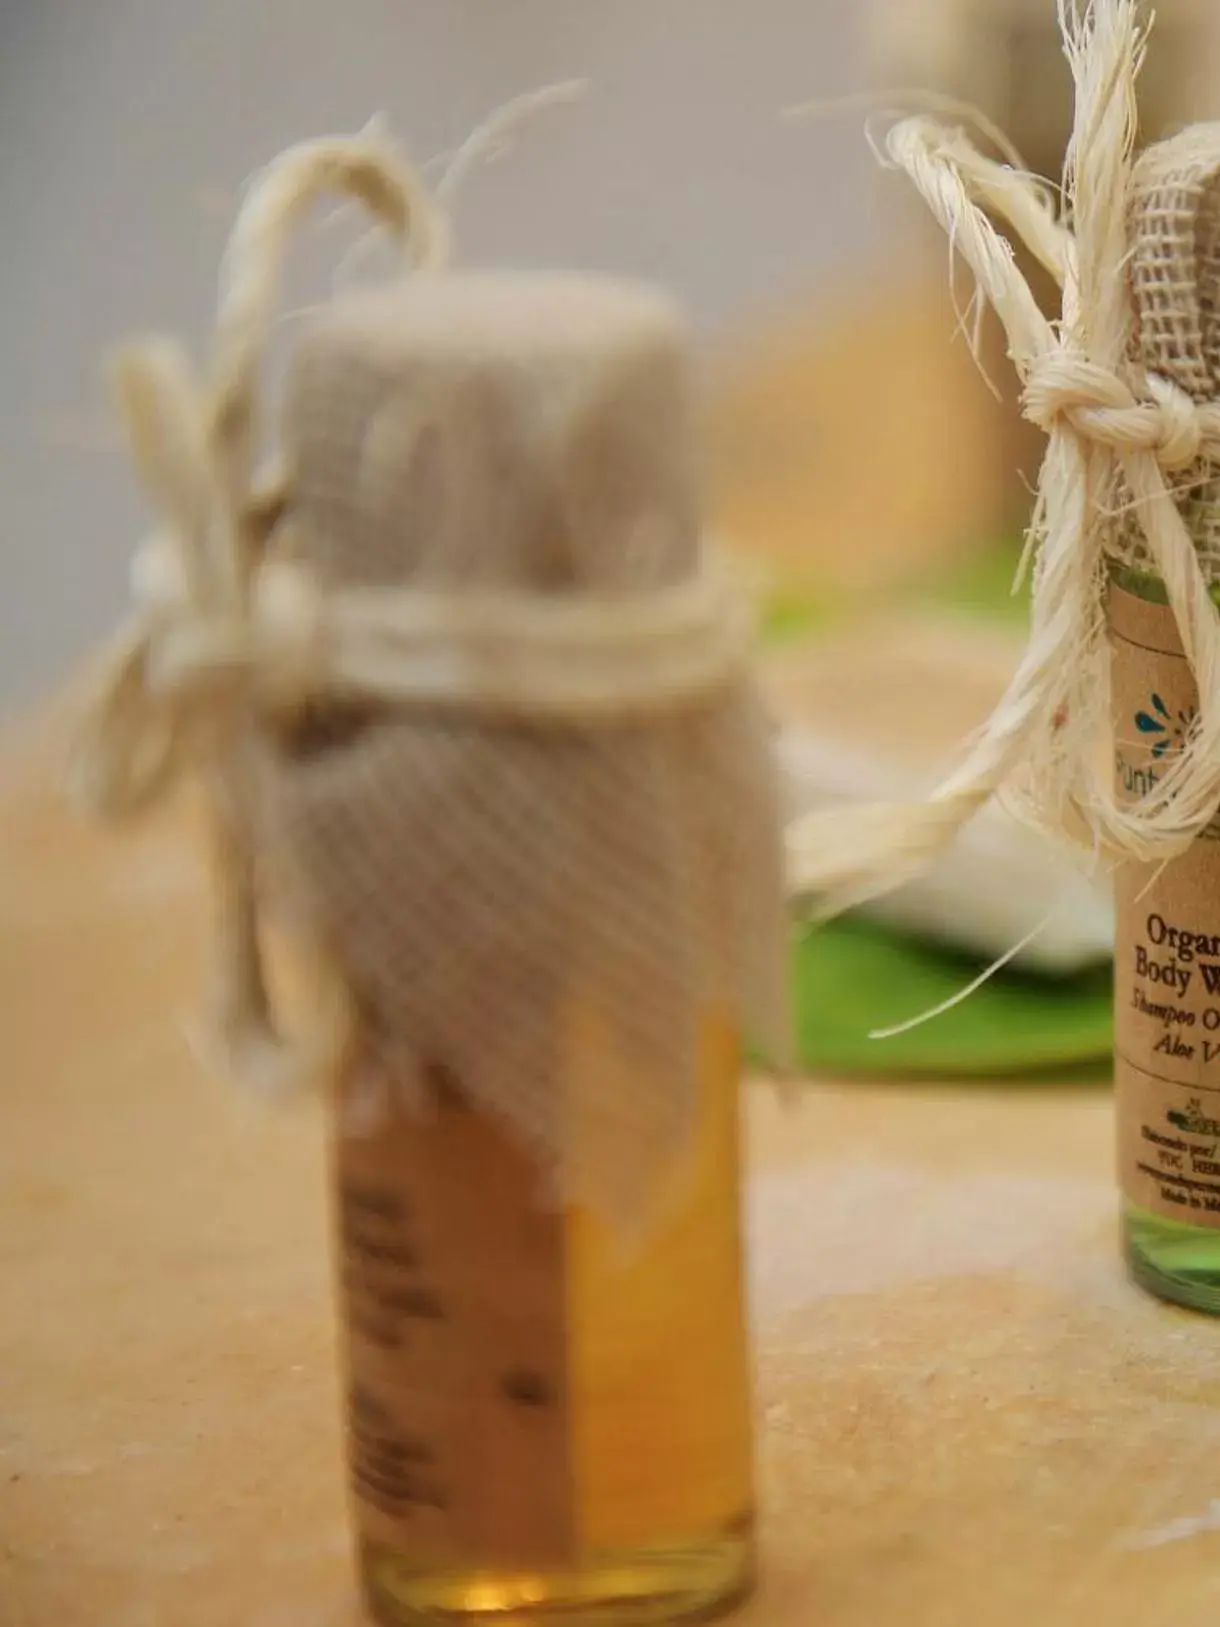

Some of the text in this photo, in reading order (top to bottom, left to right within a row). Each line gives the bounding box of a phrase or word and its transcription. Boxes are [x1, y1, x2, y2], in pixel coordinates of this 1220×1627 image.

[1135, 945, 1193, 999] Body
[1130, 986, 1196, 1028] Shampoo
[1152, 1033, 1195, 1060] Aloe
